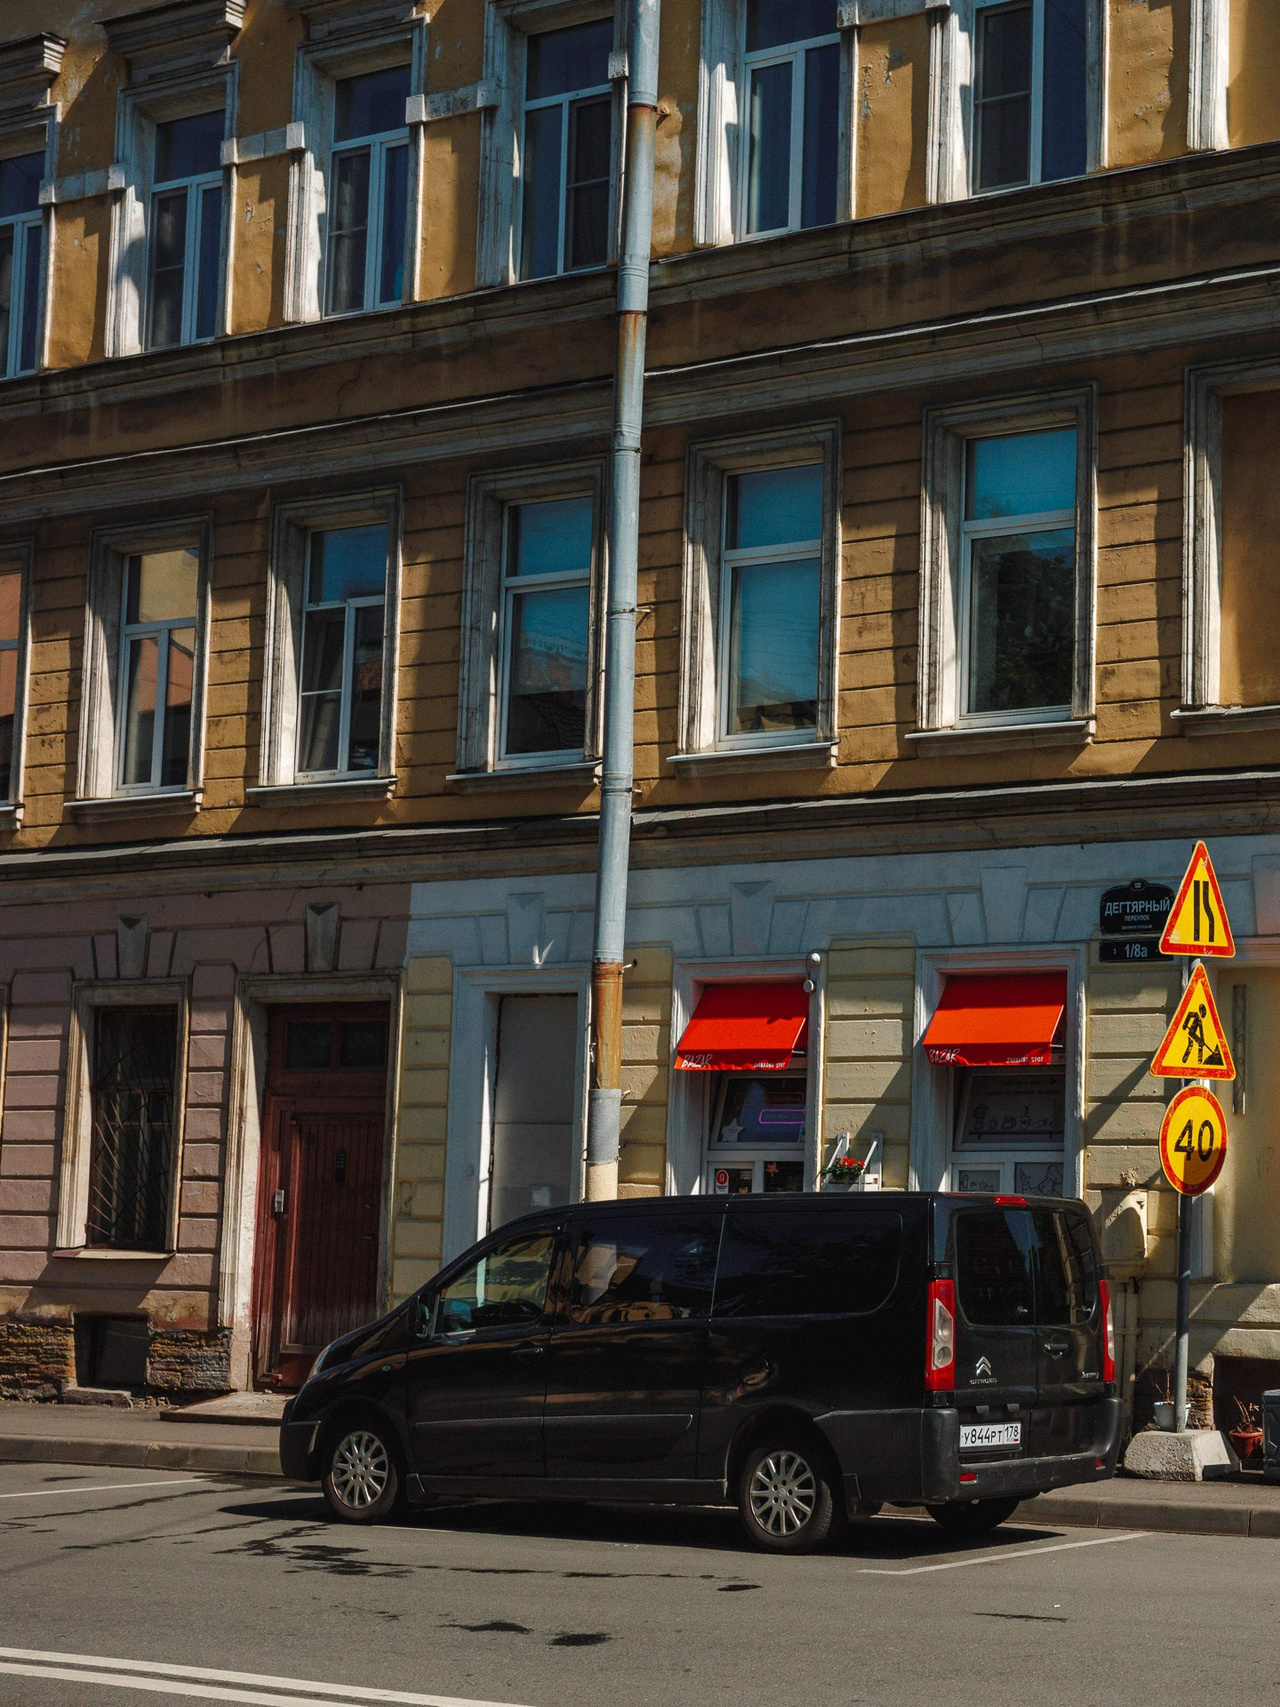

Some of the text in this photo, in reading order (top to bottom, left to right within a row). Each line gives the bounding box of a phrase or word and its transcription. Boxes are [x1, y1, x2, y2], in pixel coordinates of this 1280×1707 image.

[1105, 897, 1170, 916] ДЕГТЯРНЫЙ
[681, 1054, 714, 1068] BAZAR
[928, 1048, 960, 1063] BAZAR
[1174, 1119, 1214, 1162] 40
[1005, 1425, 1019, 1438] 178
